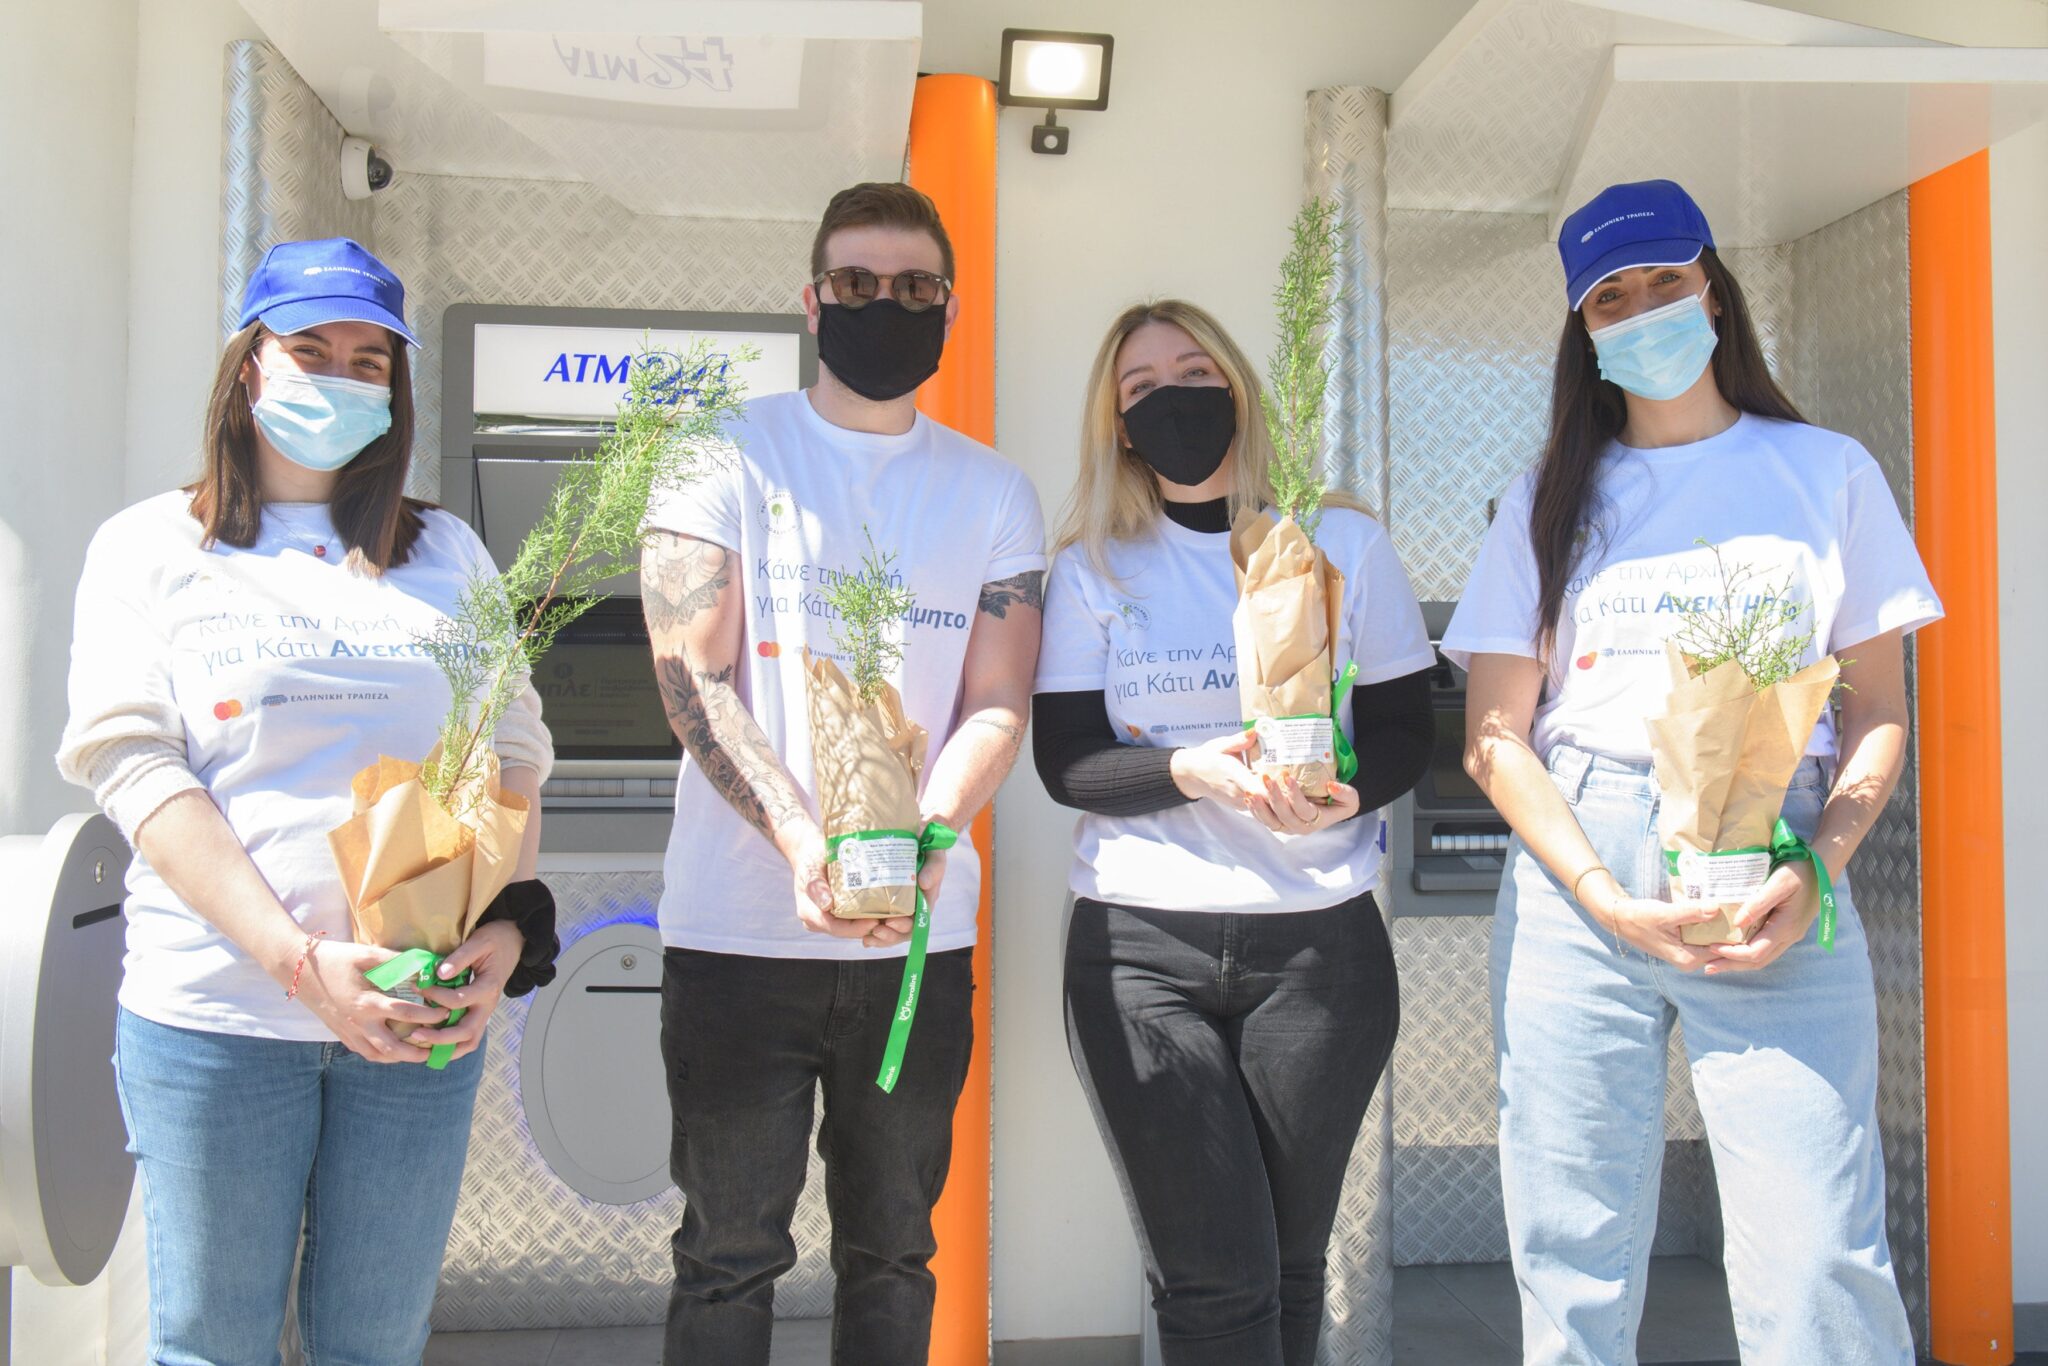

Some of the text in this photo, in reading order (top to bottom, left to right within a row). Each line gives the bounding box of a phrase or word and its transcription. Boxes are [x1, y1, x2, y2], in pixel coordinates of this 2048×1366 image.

[1594, 211, 1655, 233] ΕΛΛΗΝΙΚΗ ΤΡΑΠΕΖΑ
[757, 557, 810, 581] Κάνε
[852, 568, 903, 591] Αχή
[757, 595, 789, 619] για
[277, 615, 321, 630] την
[333, 614, 401, 635] Αρχή
[202, 647, 244, 676] για
[256, 637, 321, 659] Κάτι
[1167, 648, 1202, 663] την
[290, 692, 390, 703] ΕΛΛΗΝΙΚΗ ΤΡΑΠΕΖΑ
[1114, 681, 1140, 704] για
[1147, 671, 1195, 695] Κάτι
[1170, 720, 1243, 732] ΕΛΛΗΝΙΚΗ ΤΡΑΠΕΖ
